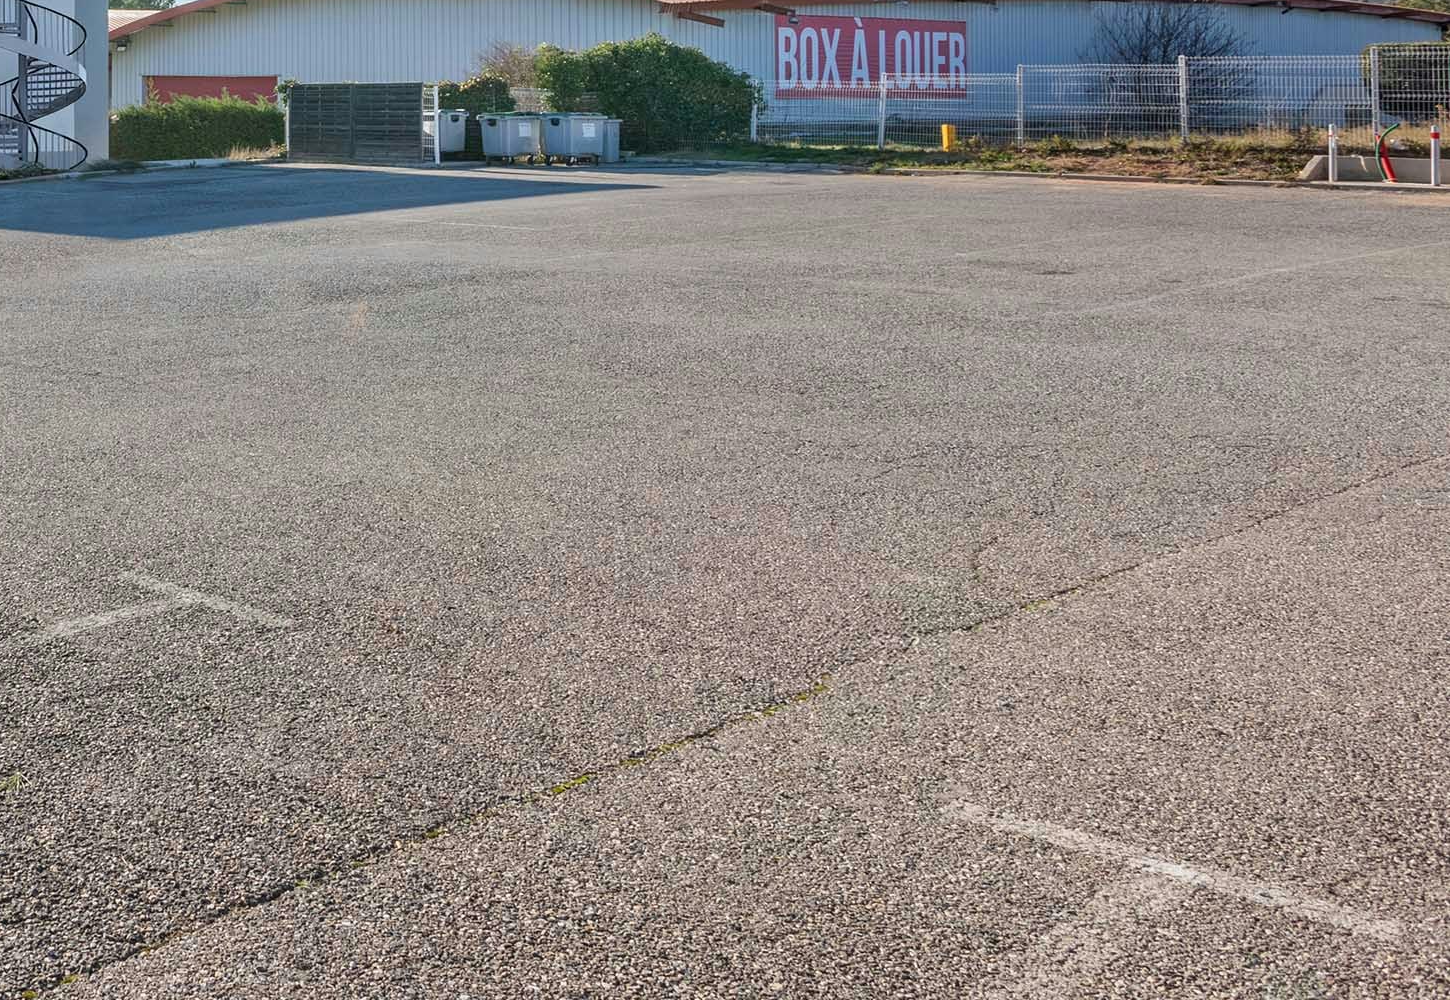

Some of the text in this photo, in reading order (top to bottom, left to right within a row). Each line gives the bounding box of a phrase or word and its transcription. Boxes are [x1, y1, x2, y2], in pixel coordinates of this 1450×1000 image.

[778, 16, 966, 89] BOX À LOUER
